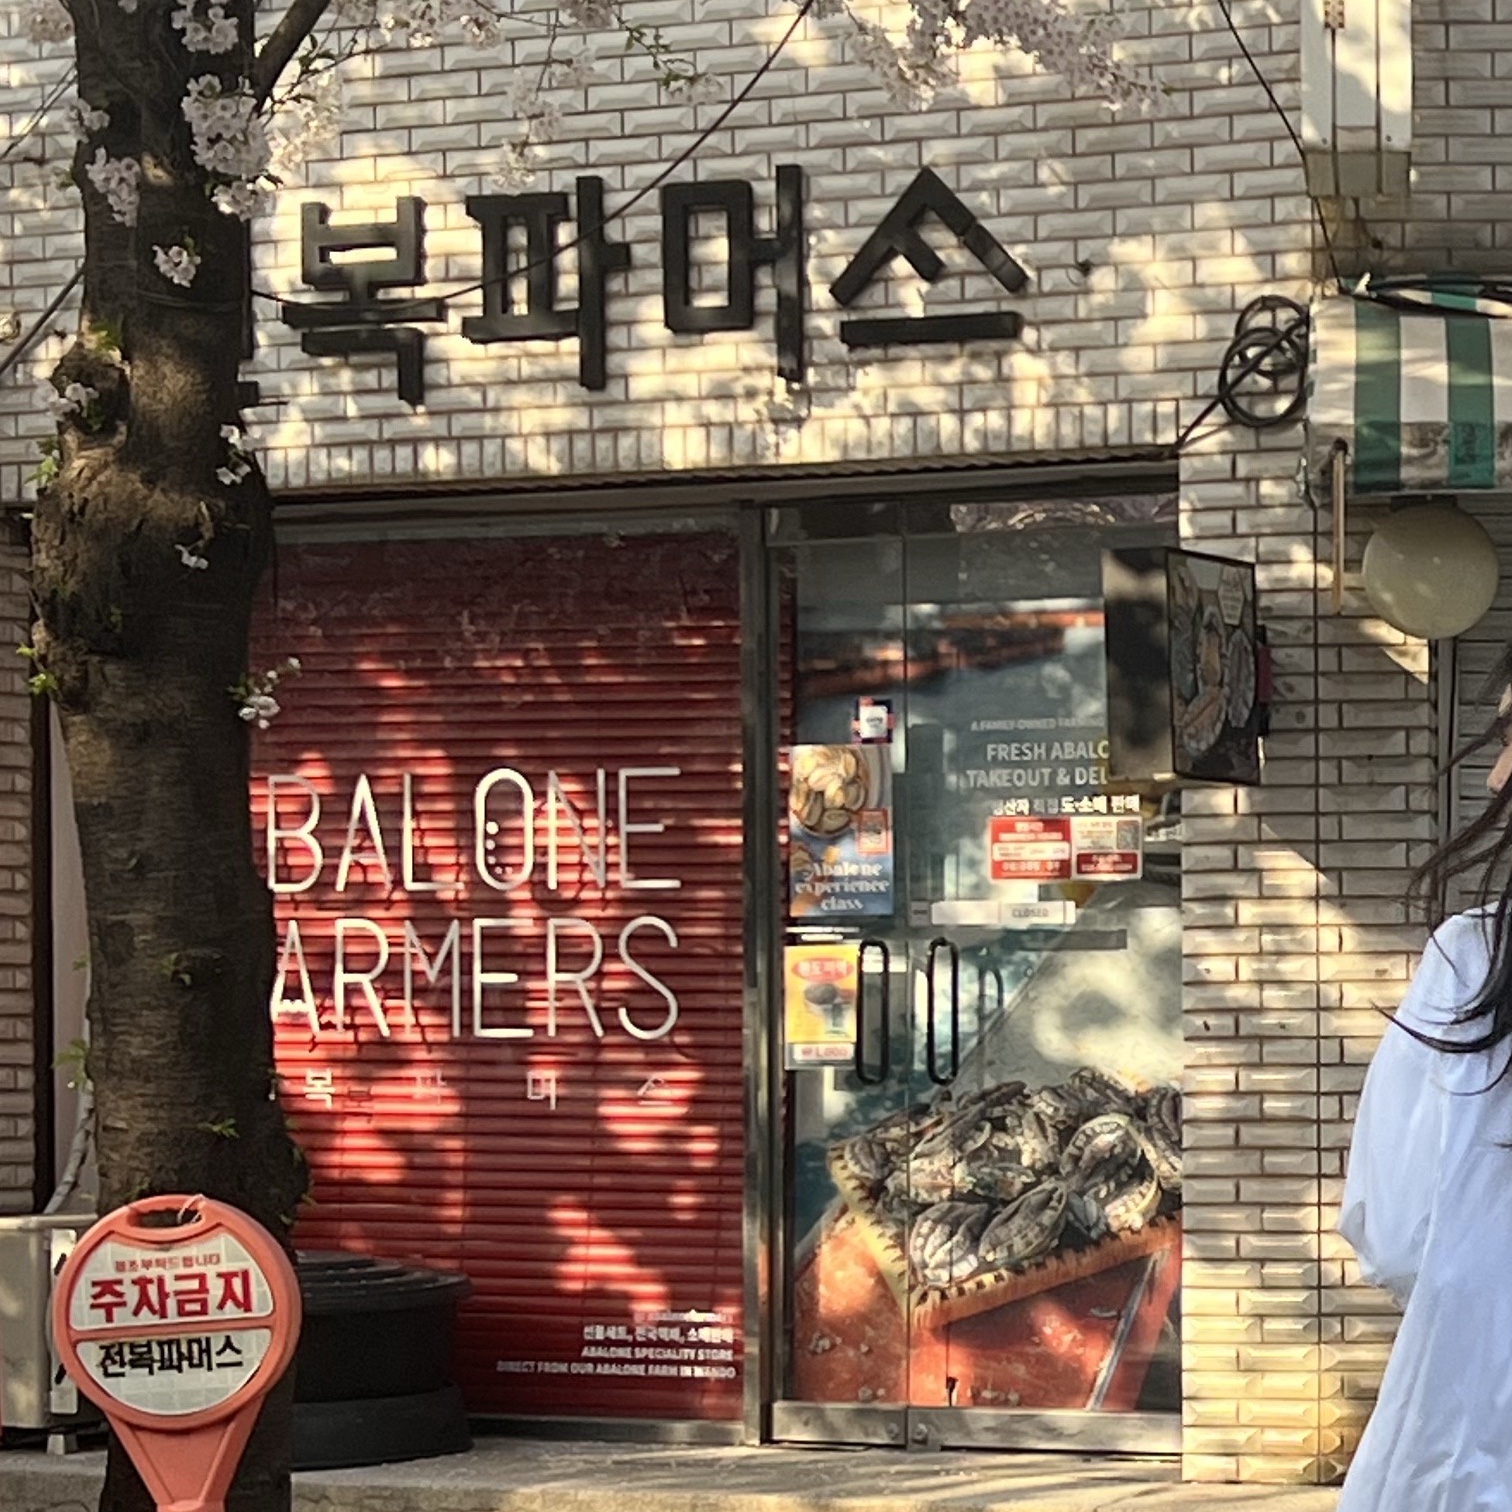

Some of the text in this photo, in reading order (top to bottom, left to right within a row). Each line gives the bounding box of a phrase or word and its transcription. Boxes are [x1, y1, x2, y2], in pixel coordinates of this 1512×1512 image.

[240, 164, 1028, 408] 복파머스
[987, 740, 1110, 762] FRESH ABALO
[966, 766, 1109, 788] TAKEOUT & DEL
[266, 767, 681, 893] BALONE
[270, 916, 679, 1039] ARMERS
[90, 1269, 253, 1323] 주차금지
[99, 1335, 243, 1378] 전복파머스
[571, 1362, 594, 1375] OUR
[596, 1363, 645, 1377] ABALONE
[581, 1346, 632, 1358] ABALONE
[697, 1348, 733, 1362] STORE
